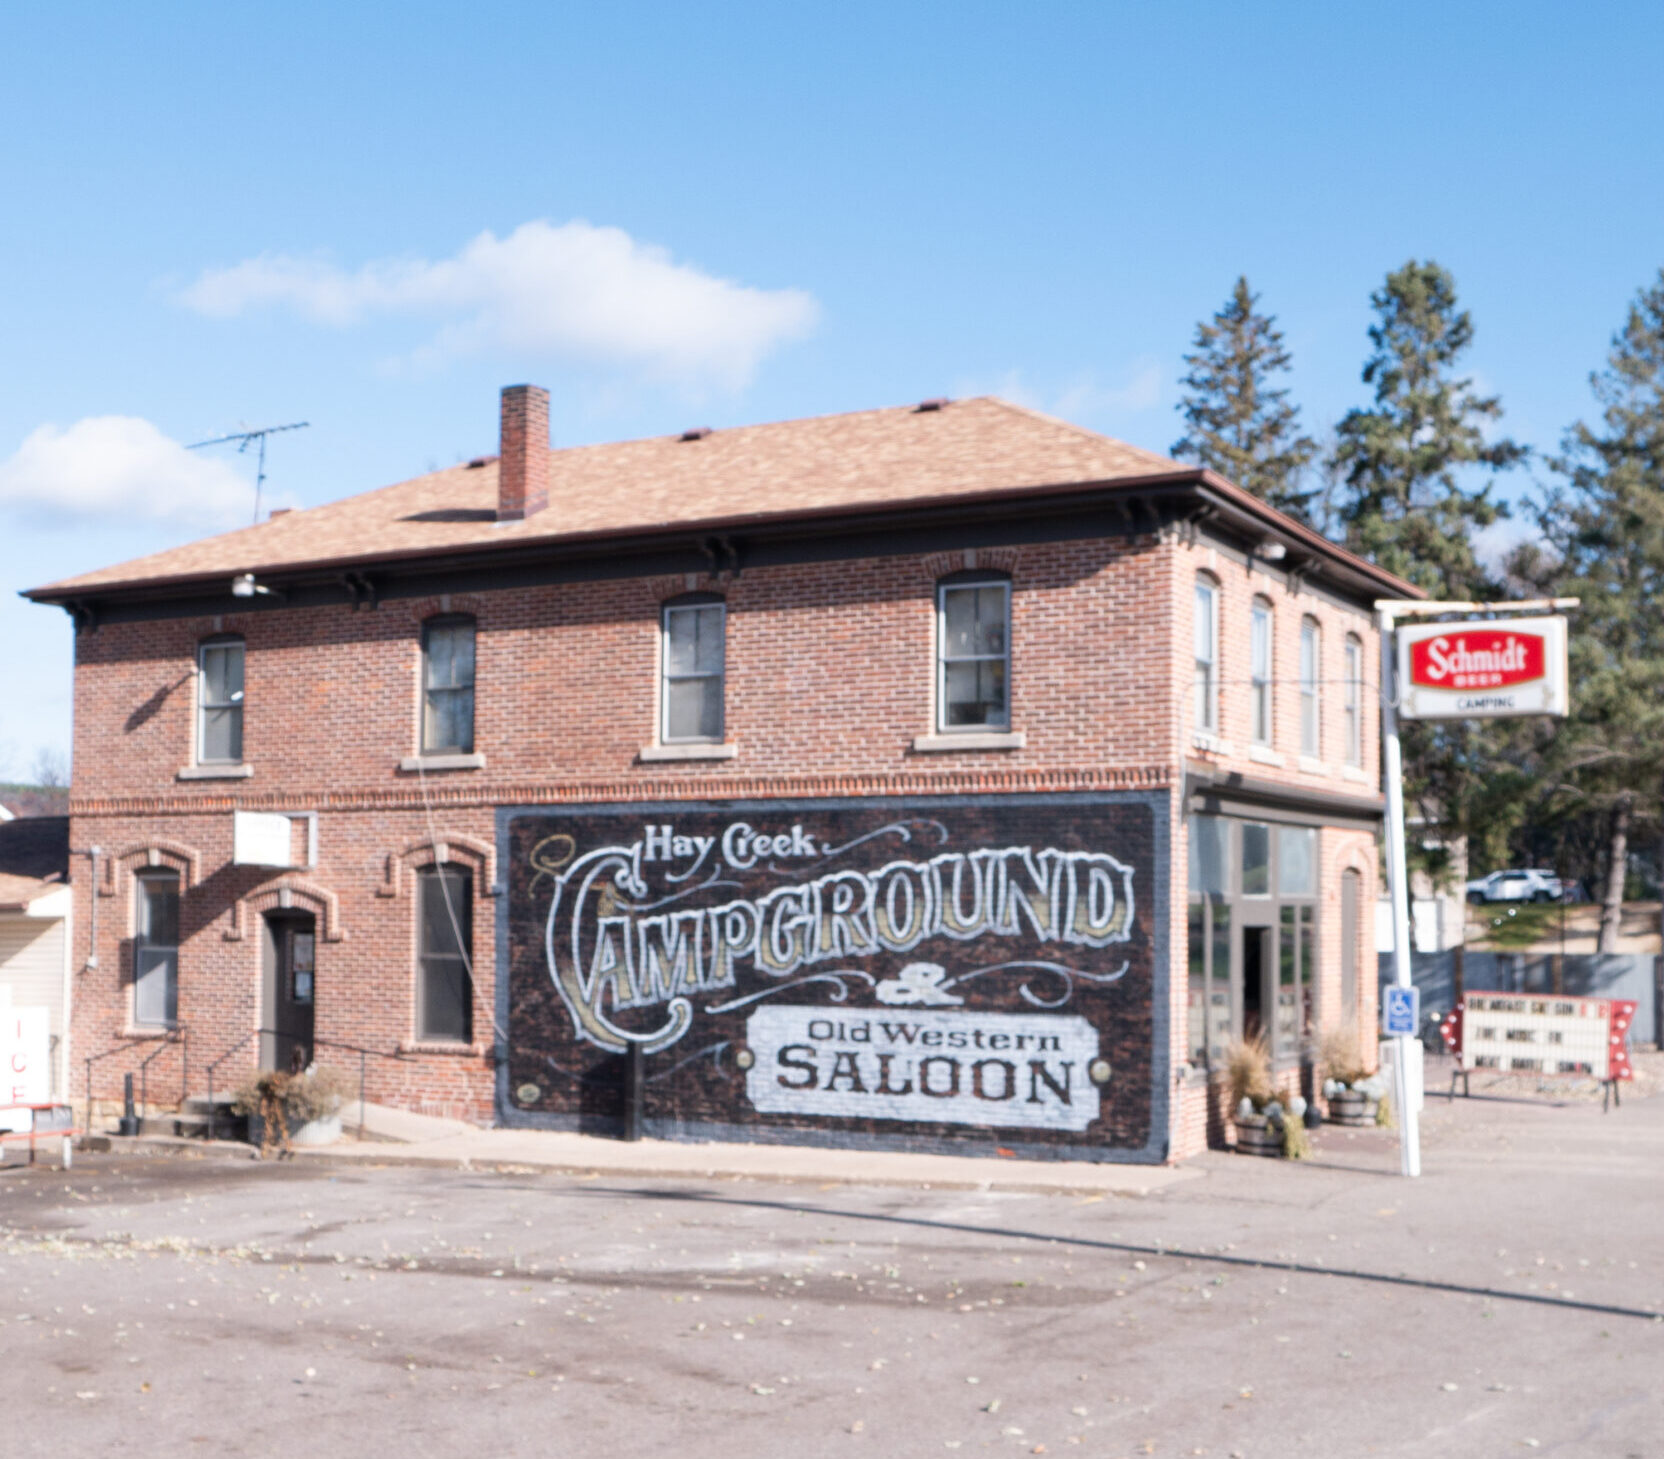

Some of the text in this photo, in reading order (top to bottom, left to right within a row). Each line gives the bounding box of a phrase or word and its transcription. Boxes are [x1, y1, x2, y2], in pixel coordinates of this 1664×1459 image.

[1426, 636, 1528, 680] Schmidt
[1454, 673, 1502, 688] BEER
[1457, 695, 1515, 709] CAMPING
[643, 822, 818, 883] Hay Creek
[545, 841, 1135, 1055] CAMPGROUND
[875, 961, 965, 1006] &
[807, 1019, 1063, 1052] Old Western
[776, 1043, 1076, 1106] SALOON
